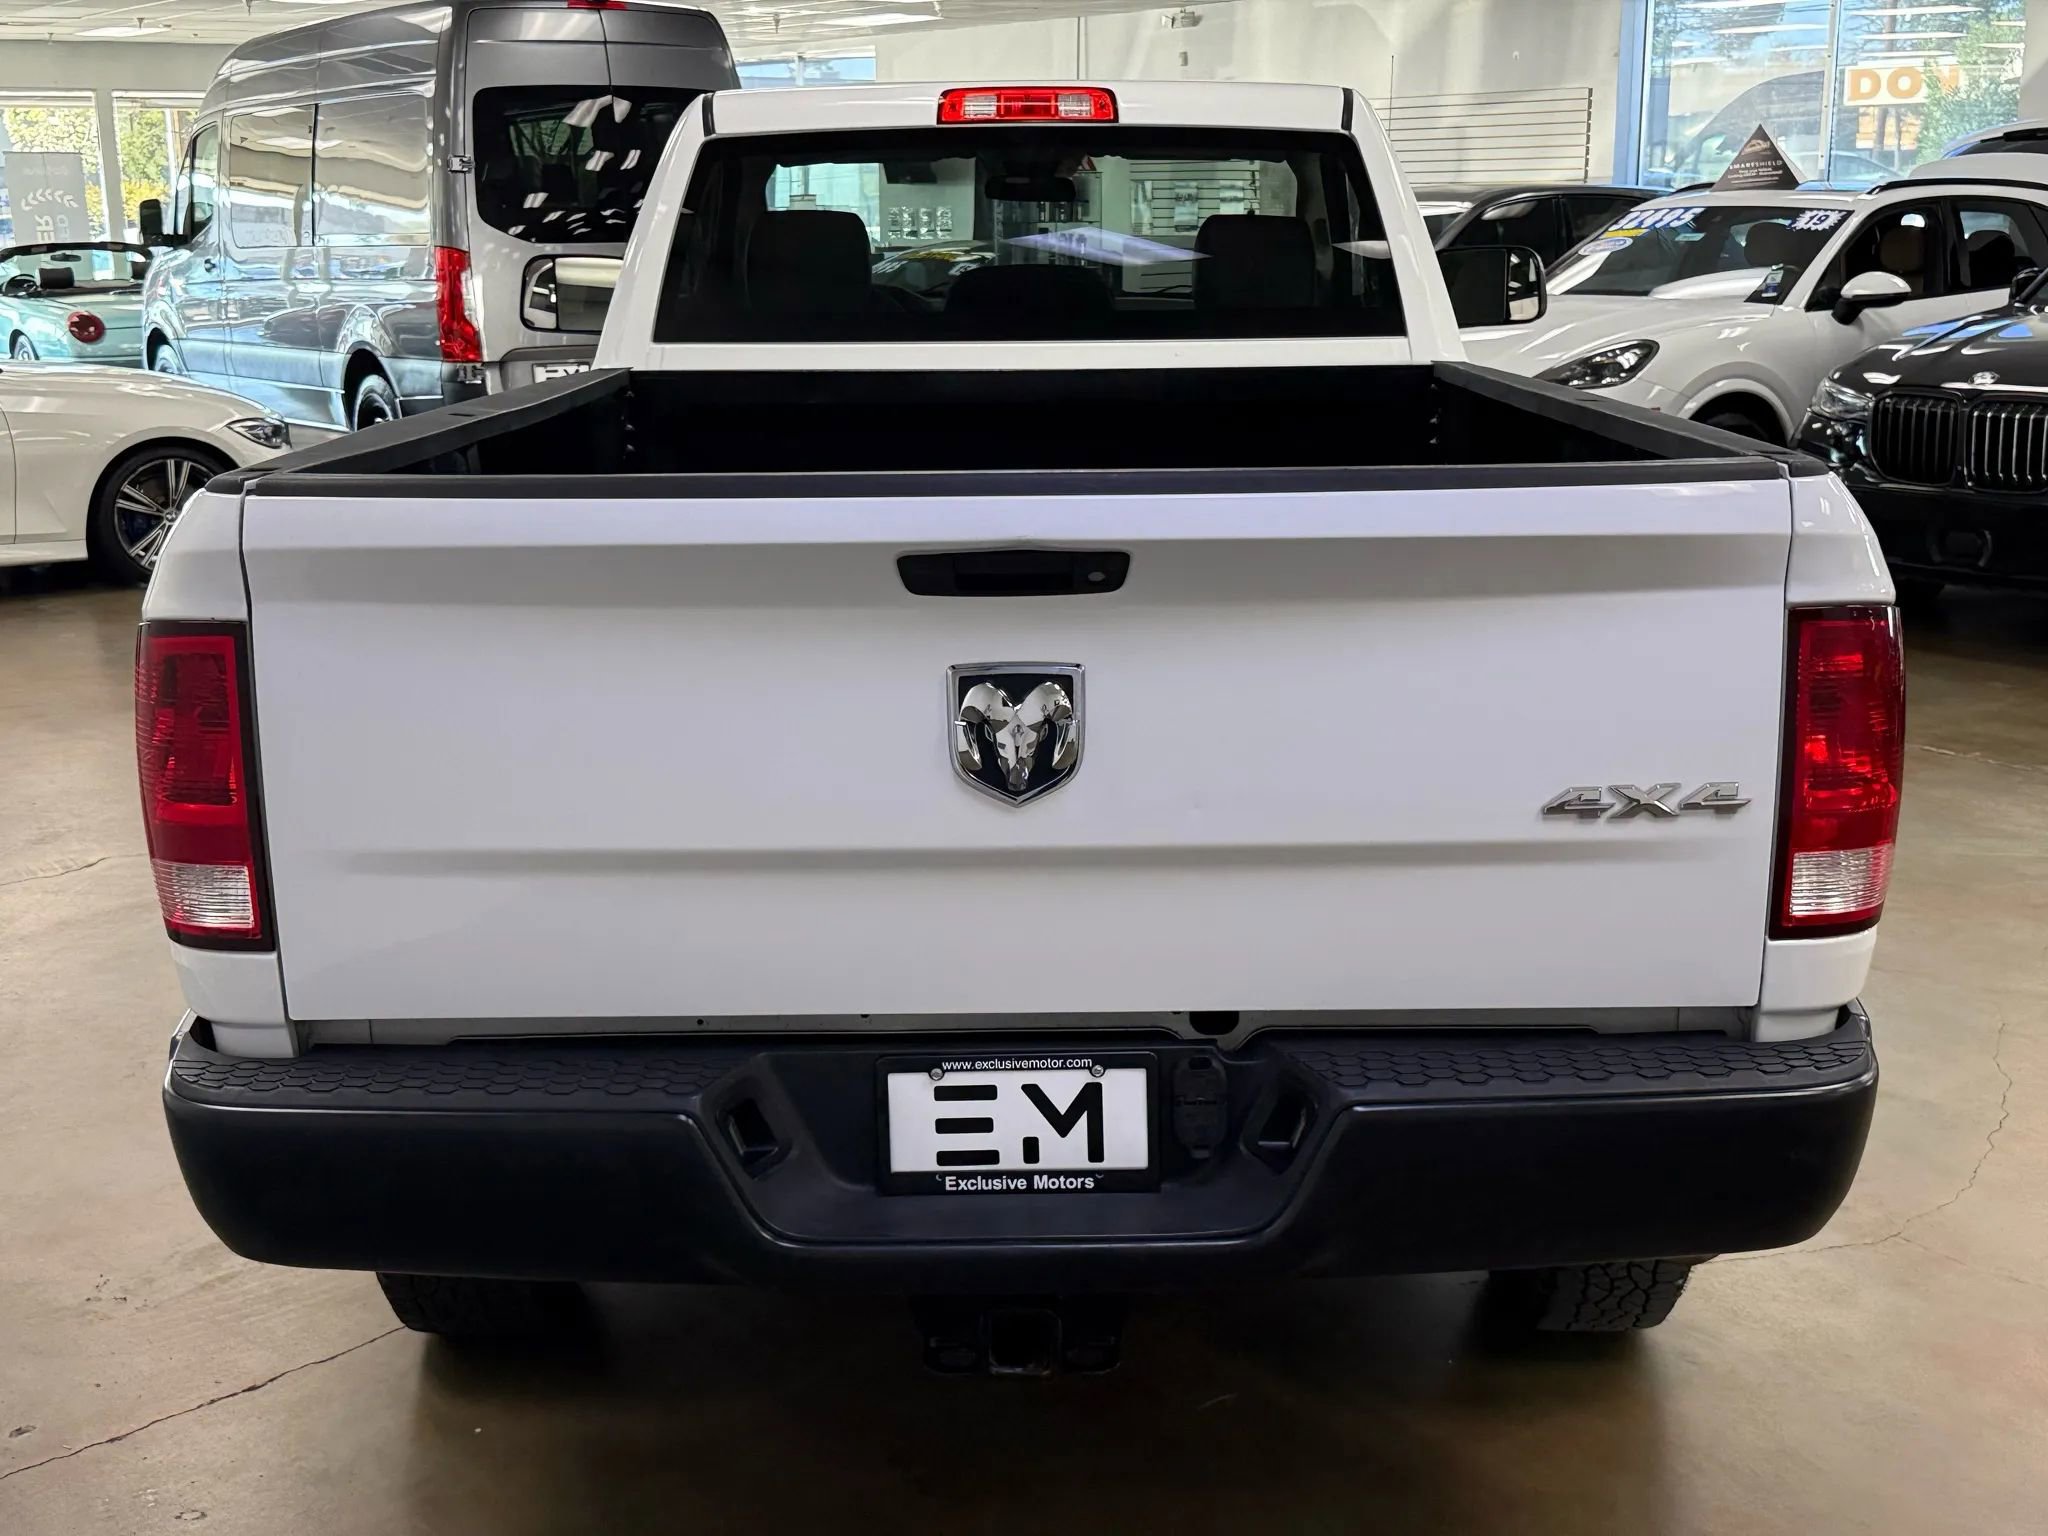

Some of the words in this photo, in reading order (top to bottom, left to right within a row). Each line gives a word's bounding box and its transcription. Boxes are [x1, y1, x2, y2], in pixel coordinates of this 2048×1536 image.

[1542, 781, 1752, 818] 4X4
[941, 1057, 1093, 1071] www.exclusivemotor.com
[945, 1175, 1028, 1191] Exclusive
[1033, 1173, 1095, 1190] Motors
